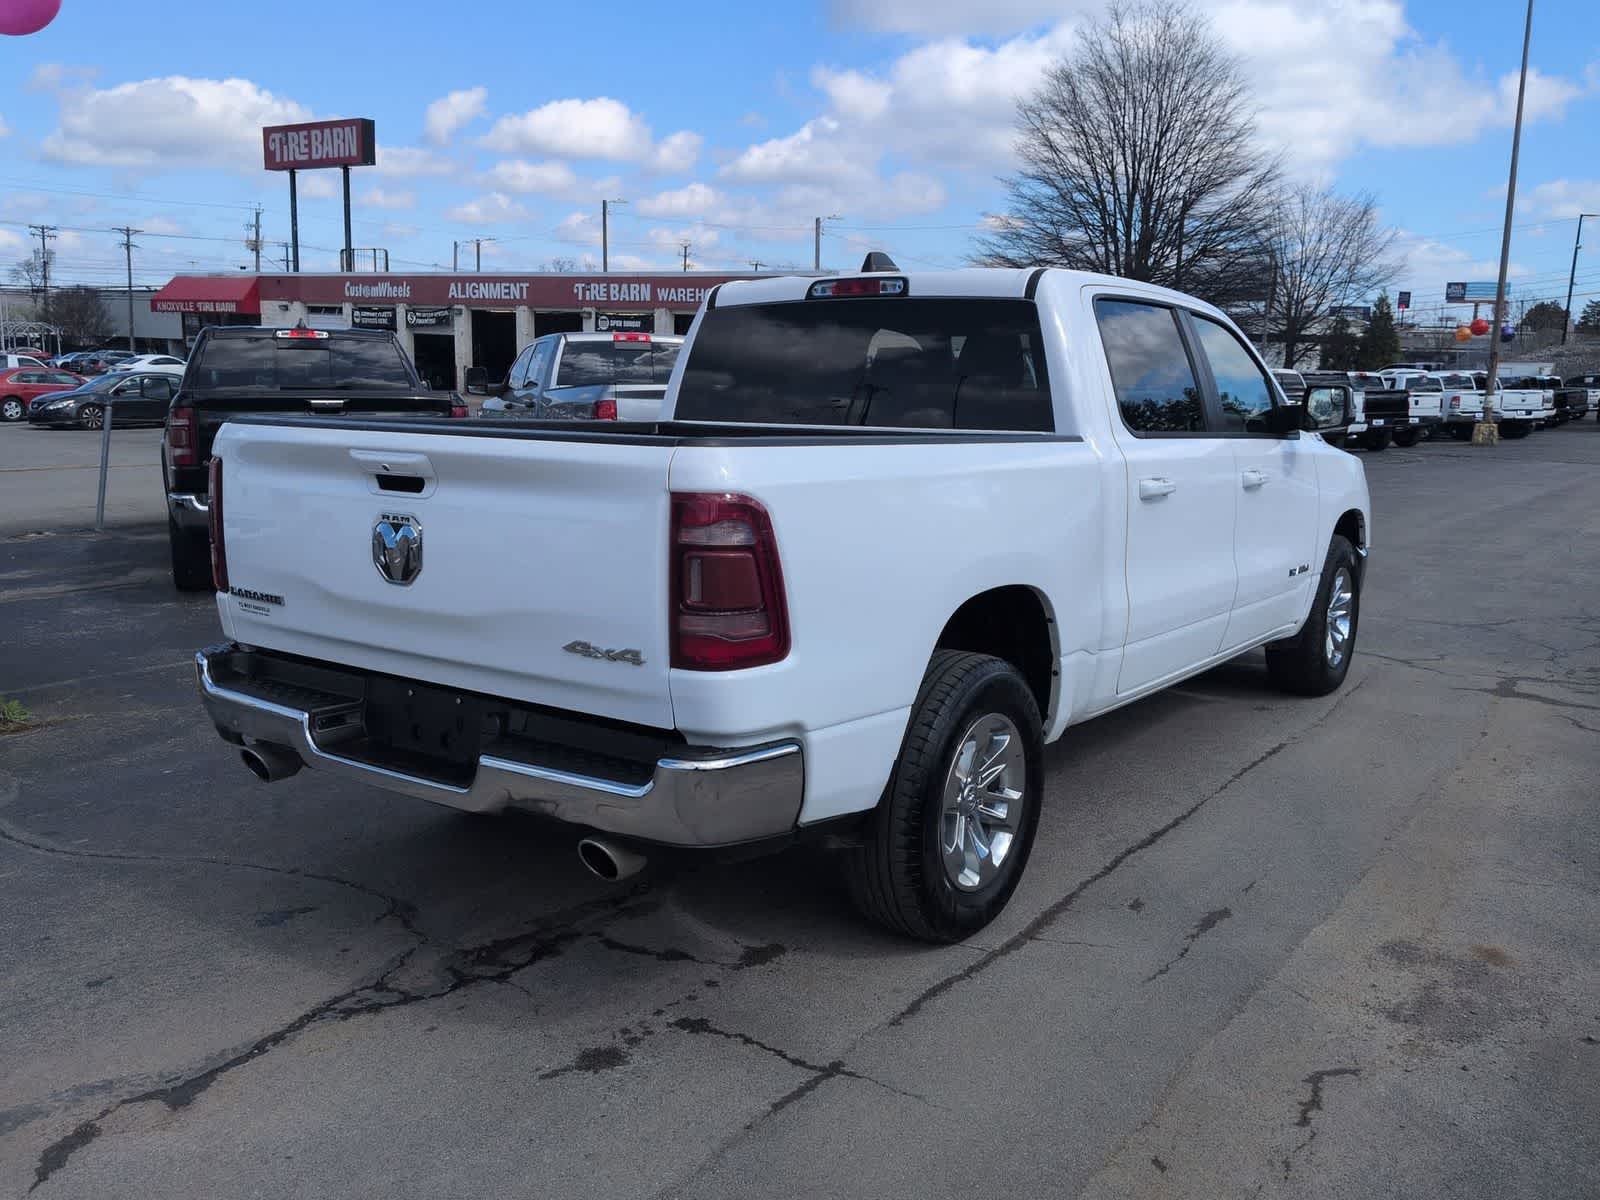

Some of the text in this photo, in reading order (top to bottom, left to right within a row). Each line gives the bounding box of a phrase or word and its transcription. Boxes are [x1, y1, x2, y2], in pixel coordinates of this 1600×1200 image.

[310, 126, 358, 160] BARN
[448, 282, 530, 300] ALIGNMENT
[609, 283, 651, 302] BARN
[382, 513, 411, 523] RAM
